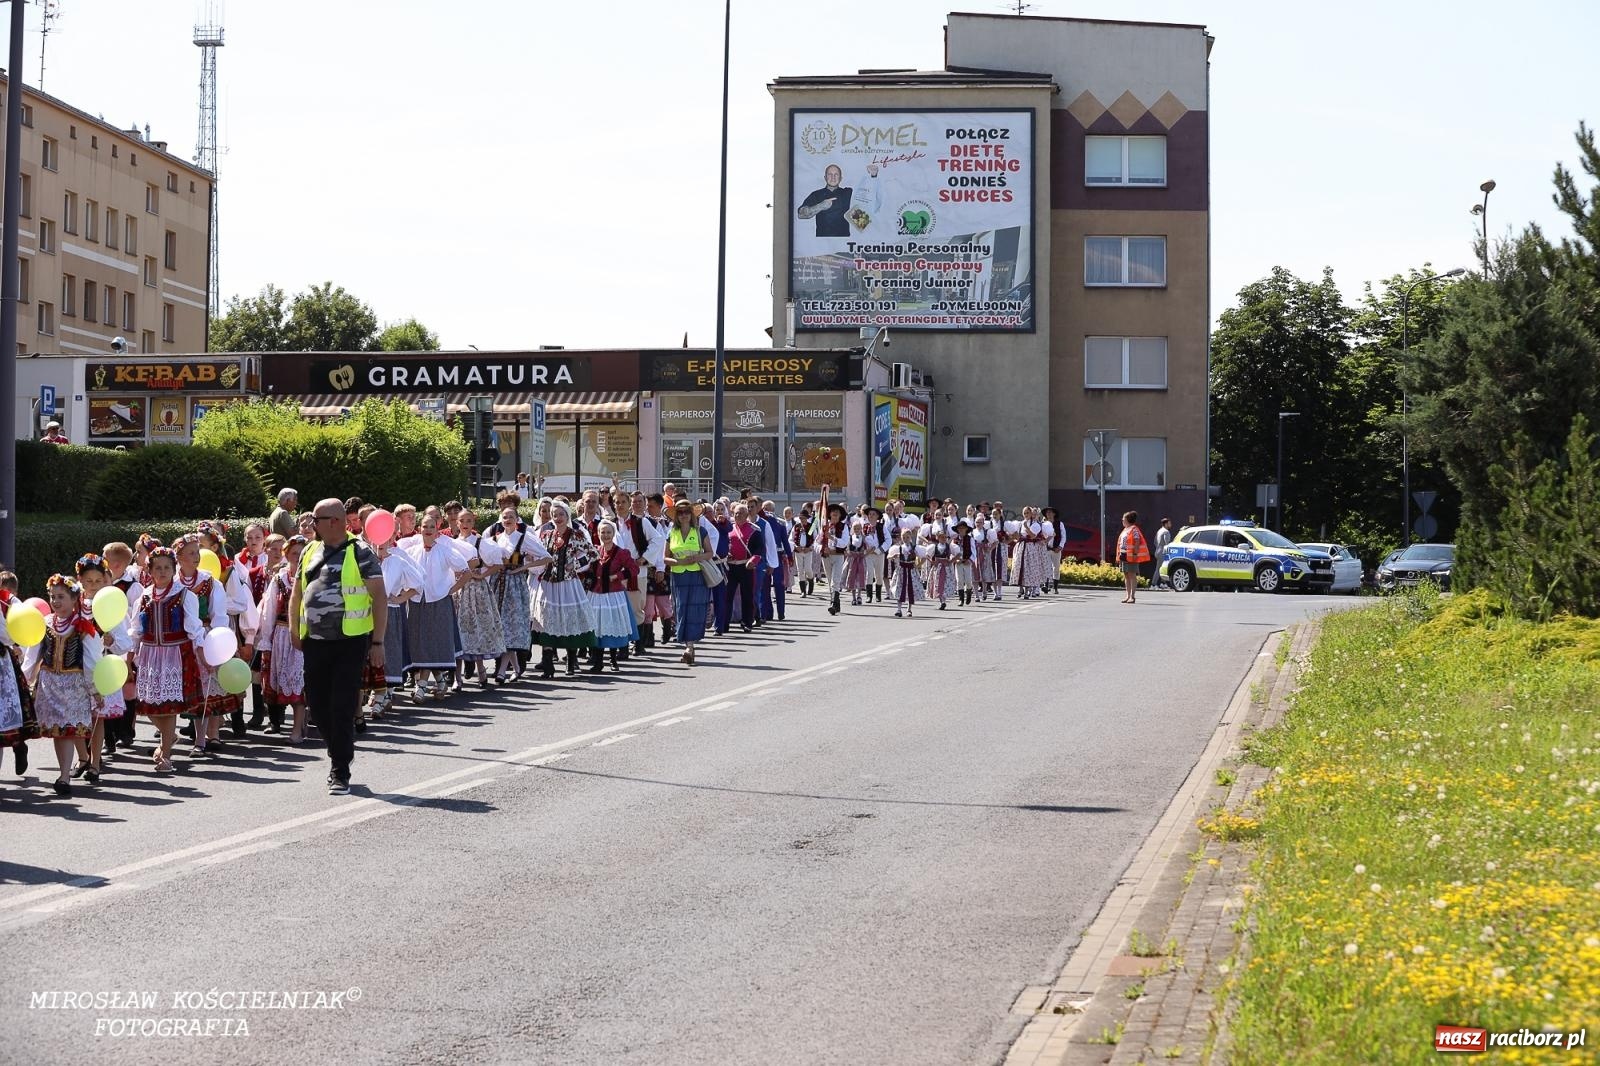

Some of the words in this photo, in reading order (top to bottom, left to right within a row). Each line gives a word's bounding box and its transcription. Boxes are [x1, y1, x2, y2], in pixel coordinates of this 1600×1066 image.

[841, 123, 928, 147] DYMEL
[945, 128, 1010, 143] POŁĄCZ
[950, 144, 1005, 160] DIETĘ
[937, 159, 1020, 172] TRENING
[947, 172, 1007, 187] ODNIEŚ
[938, 189, 1013, 202] SUKCES
[846, 242, 903, 256] Trening
[907, 242, 991, 256] Personalny
[854, 259, 911, 273] Trening
[915, 259, 983, 273] Grupowy
[863, 277, 921, 291] Trening
[925, 277, 974, 289] Junior
[930, 301, 1022, 311] #DYMEL90DNI
[686, 358, 814, 373] E-PAPIEROSY
[114, 365, 217, 383] KEBAB
[368, 365, 574, 386] GRAMATURA
[661, 410, 715, 419] E-PAPIEROSY
[785, 409, 841, 418] E-PAPIEROSY
[597, 430, 606, 453] DIETY
[1227, 553, 1251, 562] POLICJA
